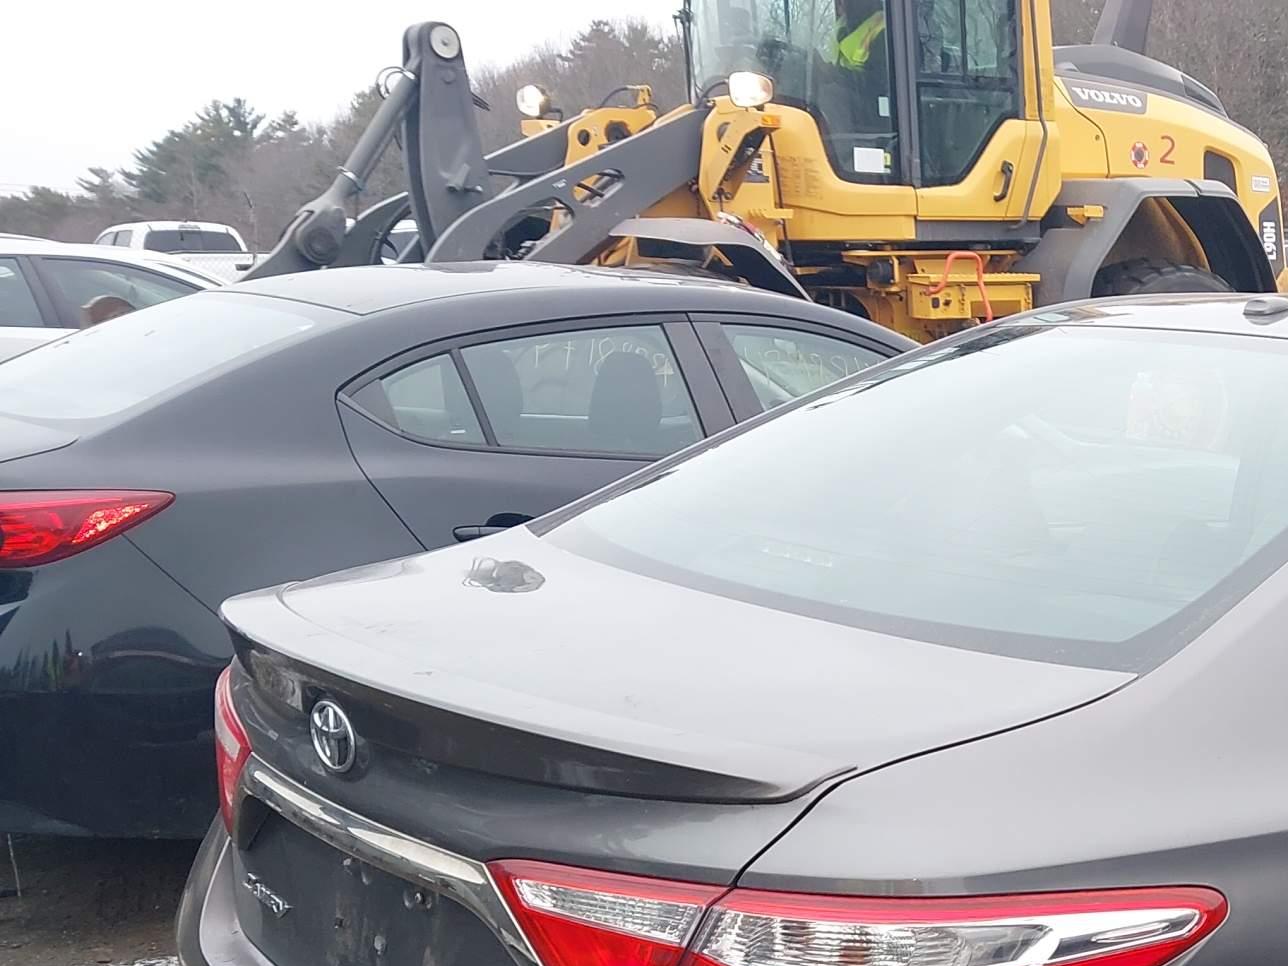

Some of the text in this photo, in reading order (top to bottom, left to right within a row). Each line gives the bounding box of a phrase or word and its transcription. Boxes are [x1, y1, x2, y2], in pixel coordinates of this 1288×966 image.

[1071, 87, 1143, 108] VOLVO
[1159, 135, 1176, 165] 2
[1262, 221, 1277, 261] L90H
